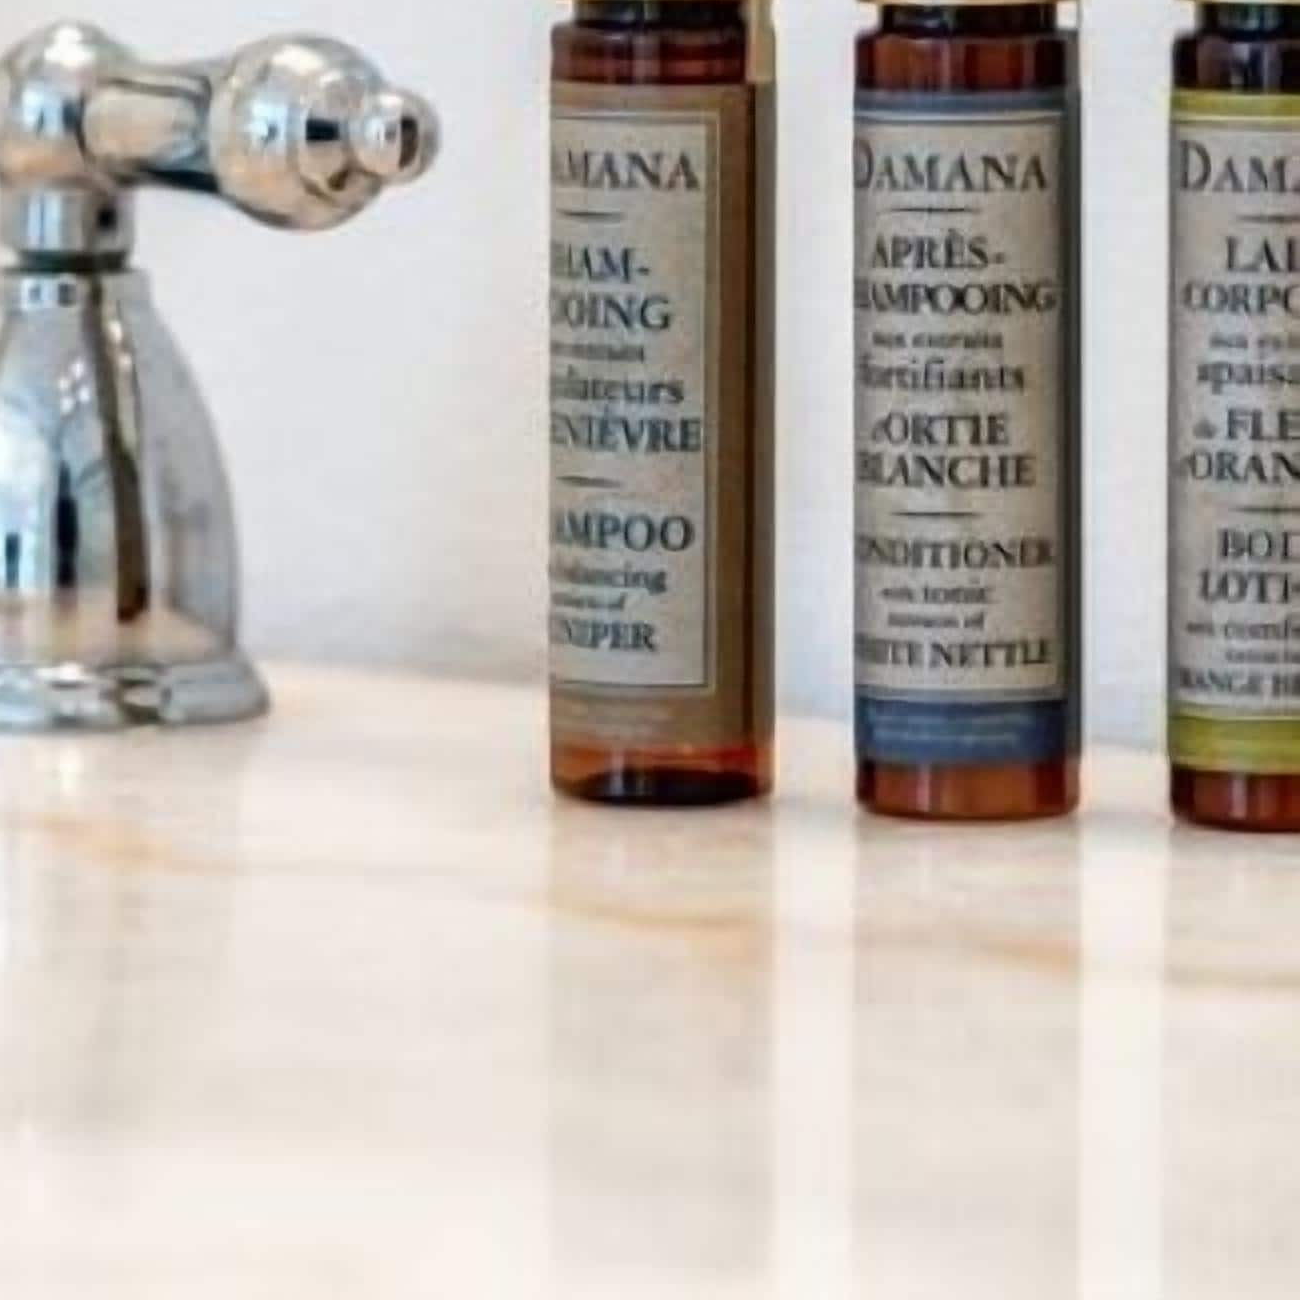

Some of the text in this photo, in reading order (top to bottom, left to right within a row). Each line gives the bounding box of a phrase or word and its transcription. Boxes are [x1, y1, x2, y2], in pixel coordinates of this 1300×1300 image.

[853, 136, 1049, 192] DAMANA
[871, 228, 1005, 269] APRÈS-
[855, 450, 1038, 489] BLANCHE
